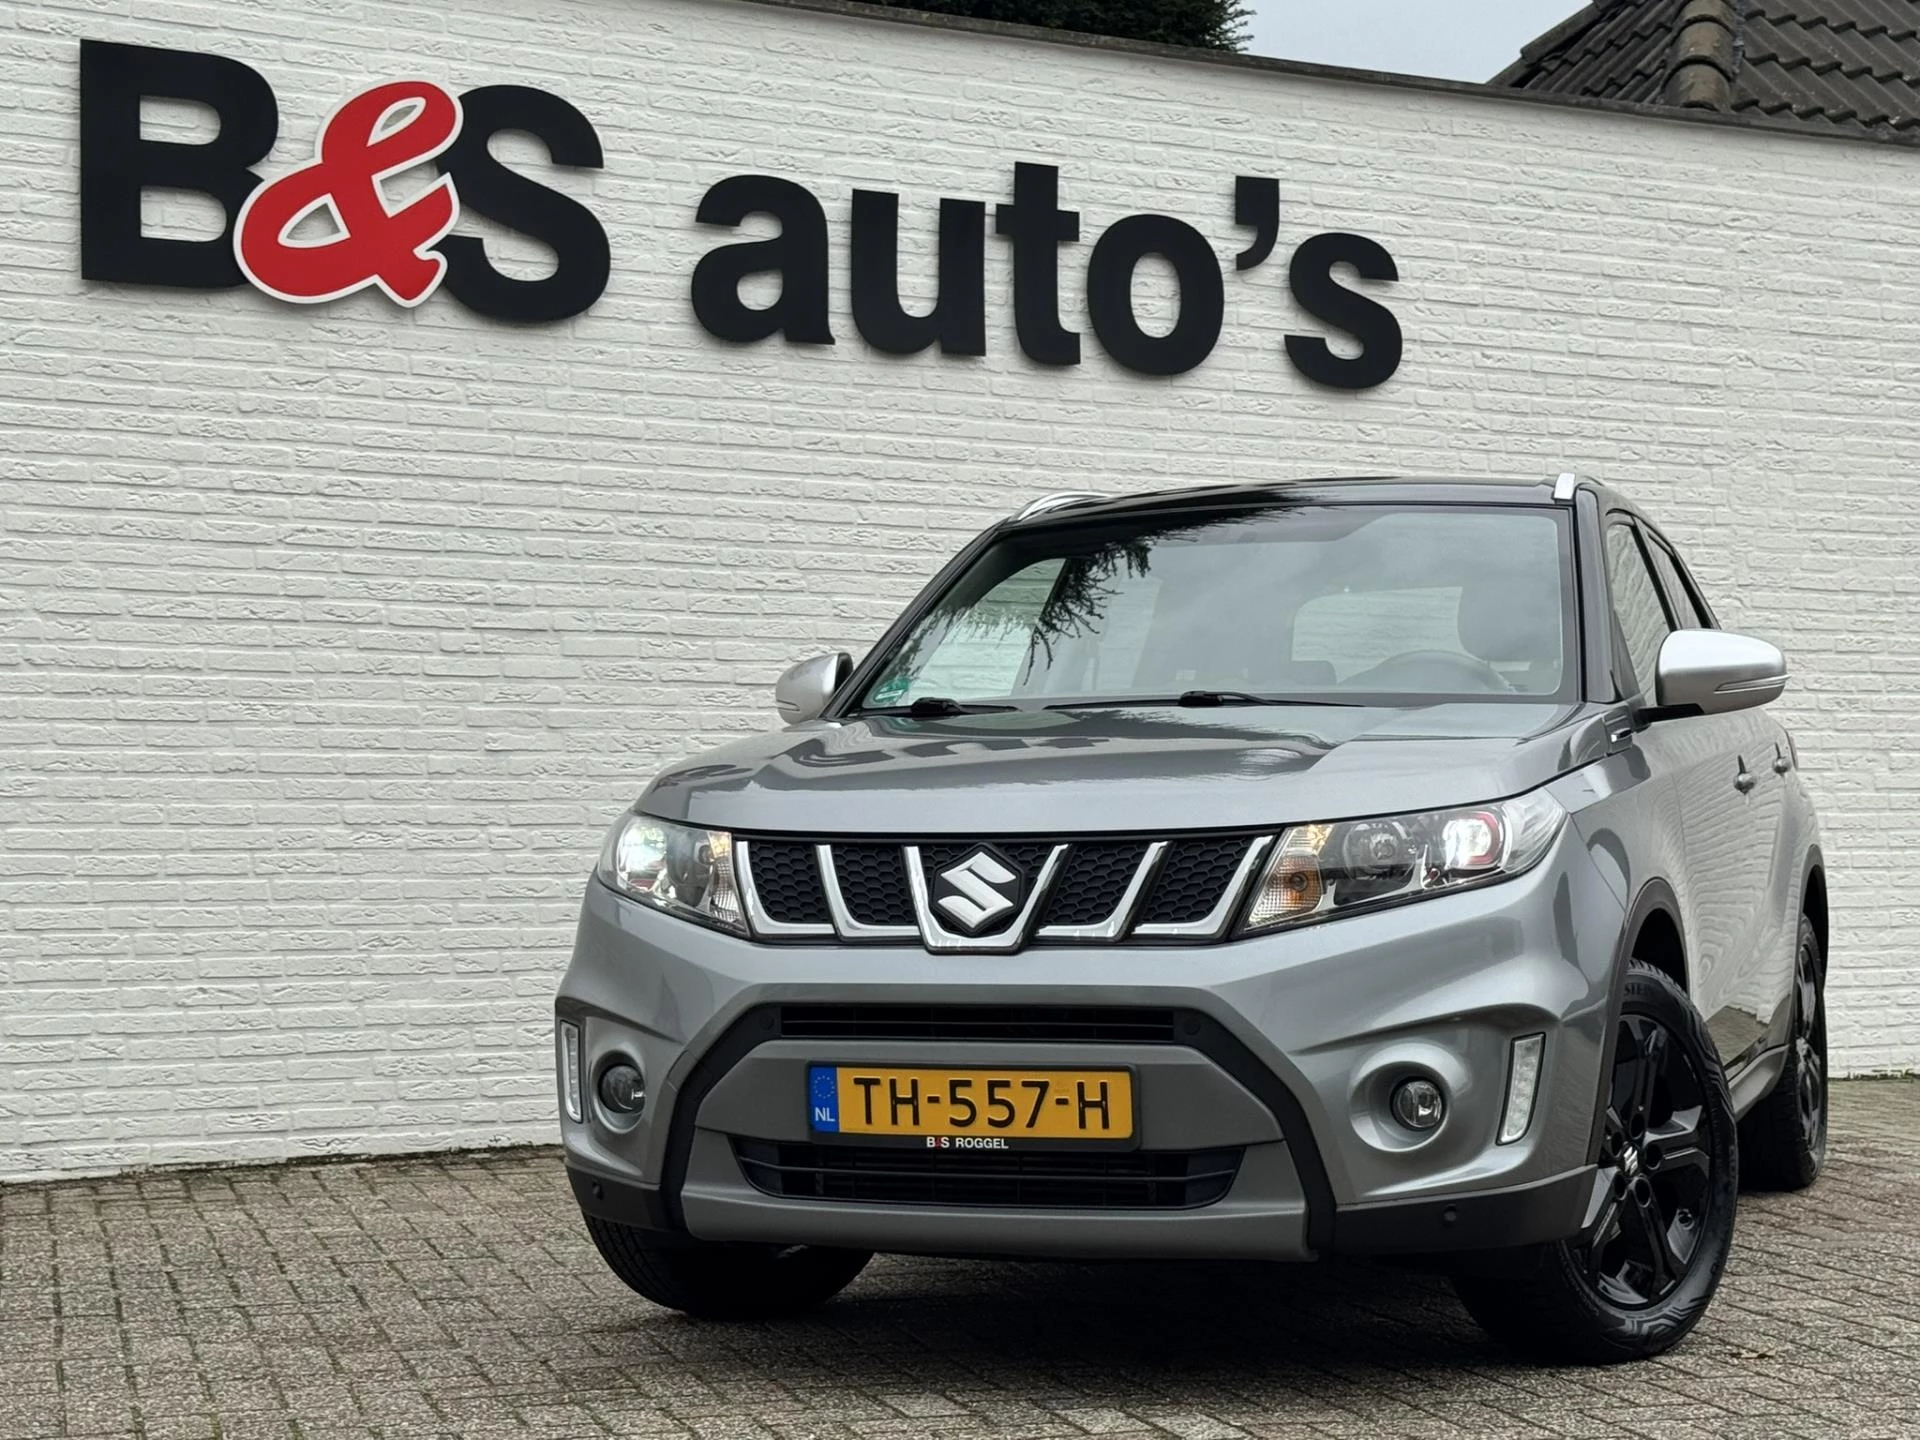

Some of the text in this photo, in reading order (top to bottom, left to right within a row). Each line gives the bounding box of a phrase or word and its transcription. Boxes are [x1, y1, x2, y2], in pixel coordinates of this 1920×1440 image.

[81, 39, 1403, 390] B&S auto's
[815, 1107, 836, 1122] NL
[853, 1077, 1110, 1129] TH-557-H
[955, 1137, 1009, 1149] ROGGEL
